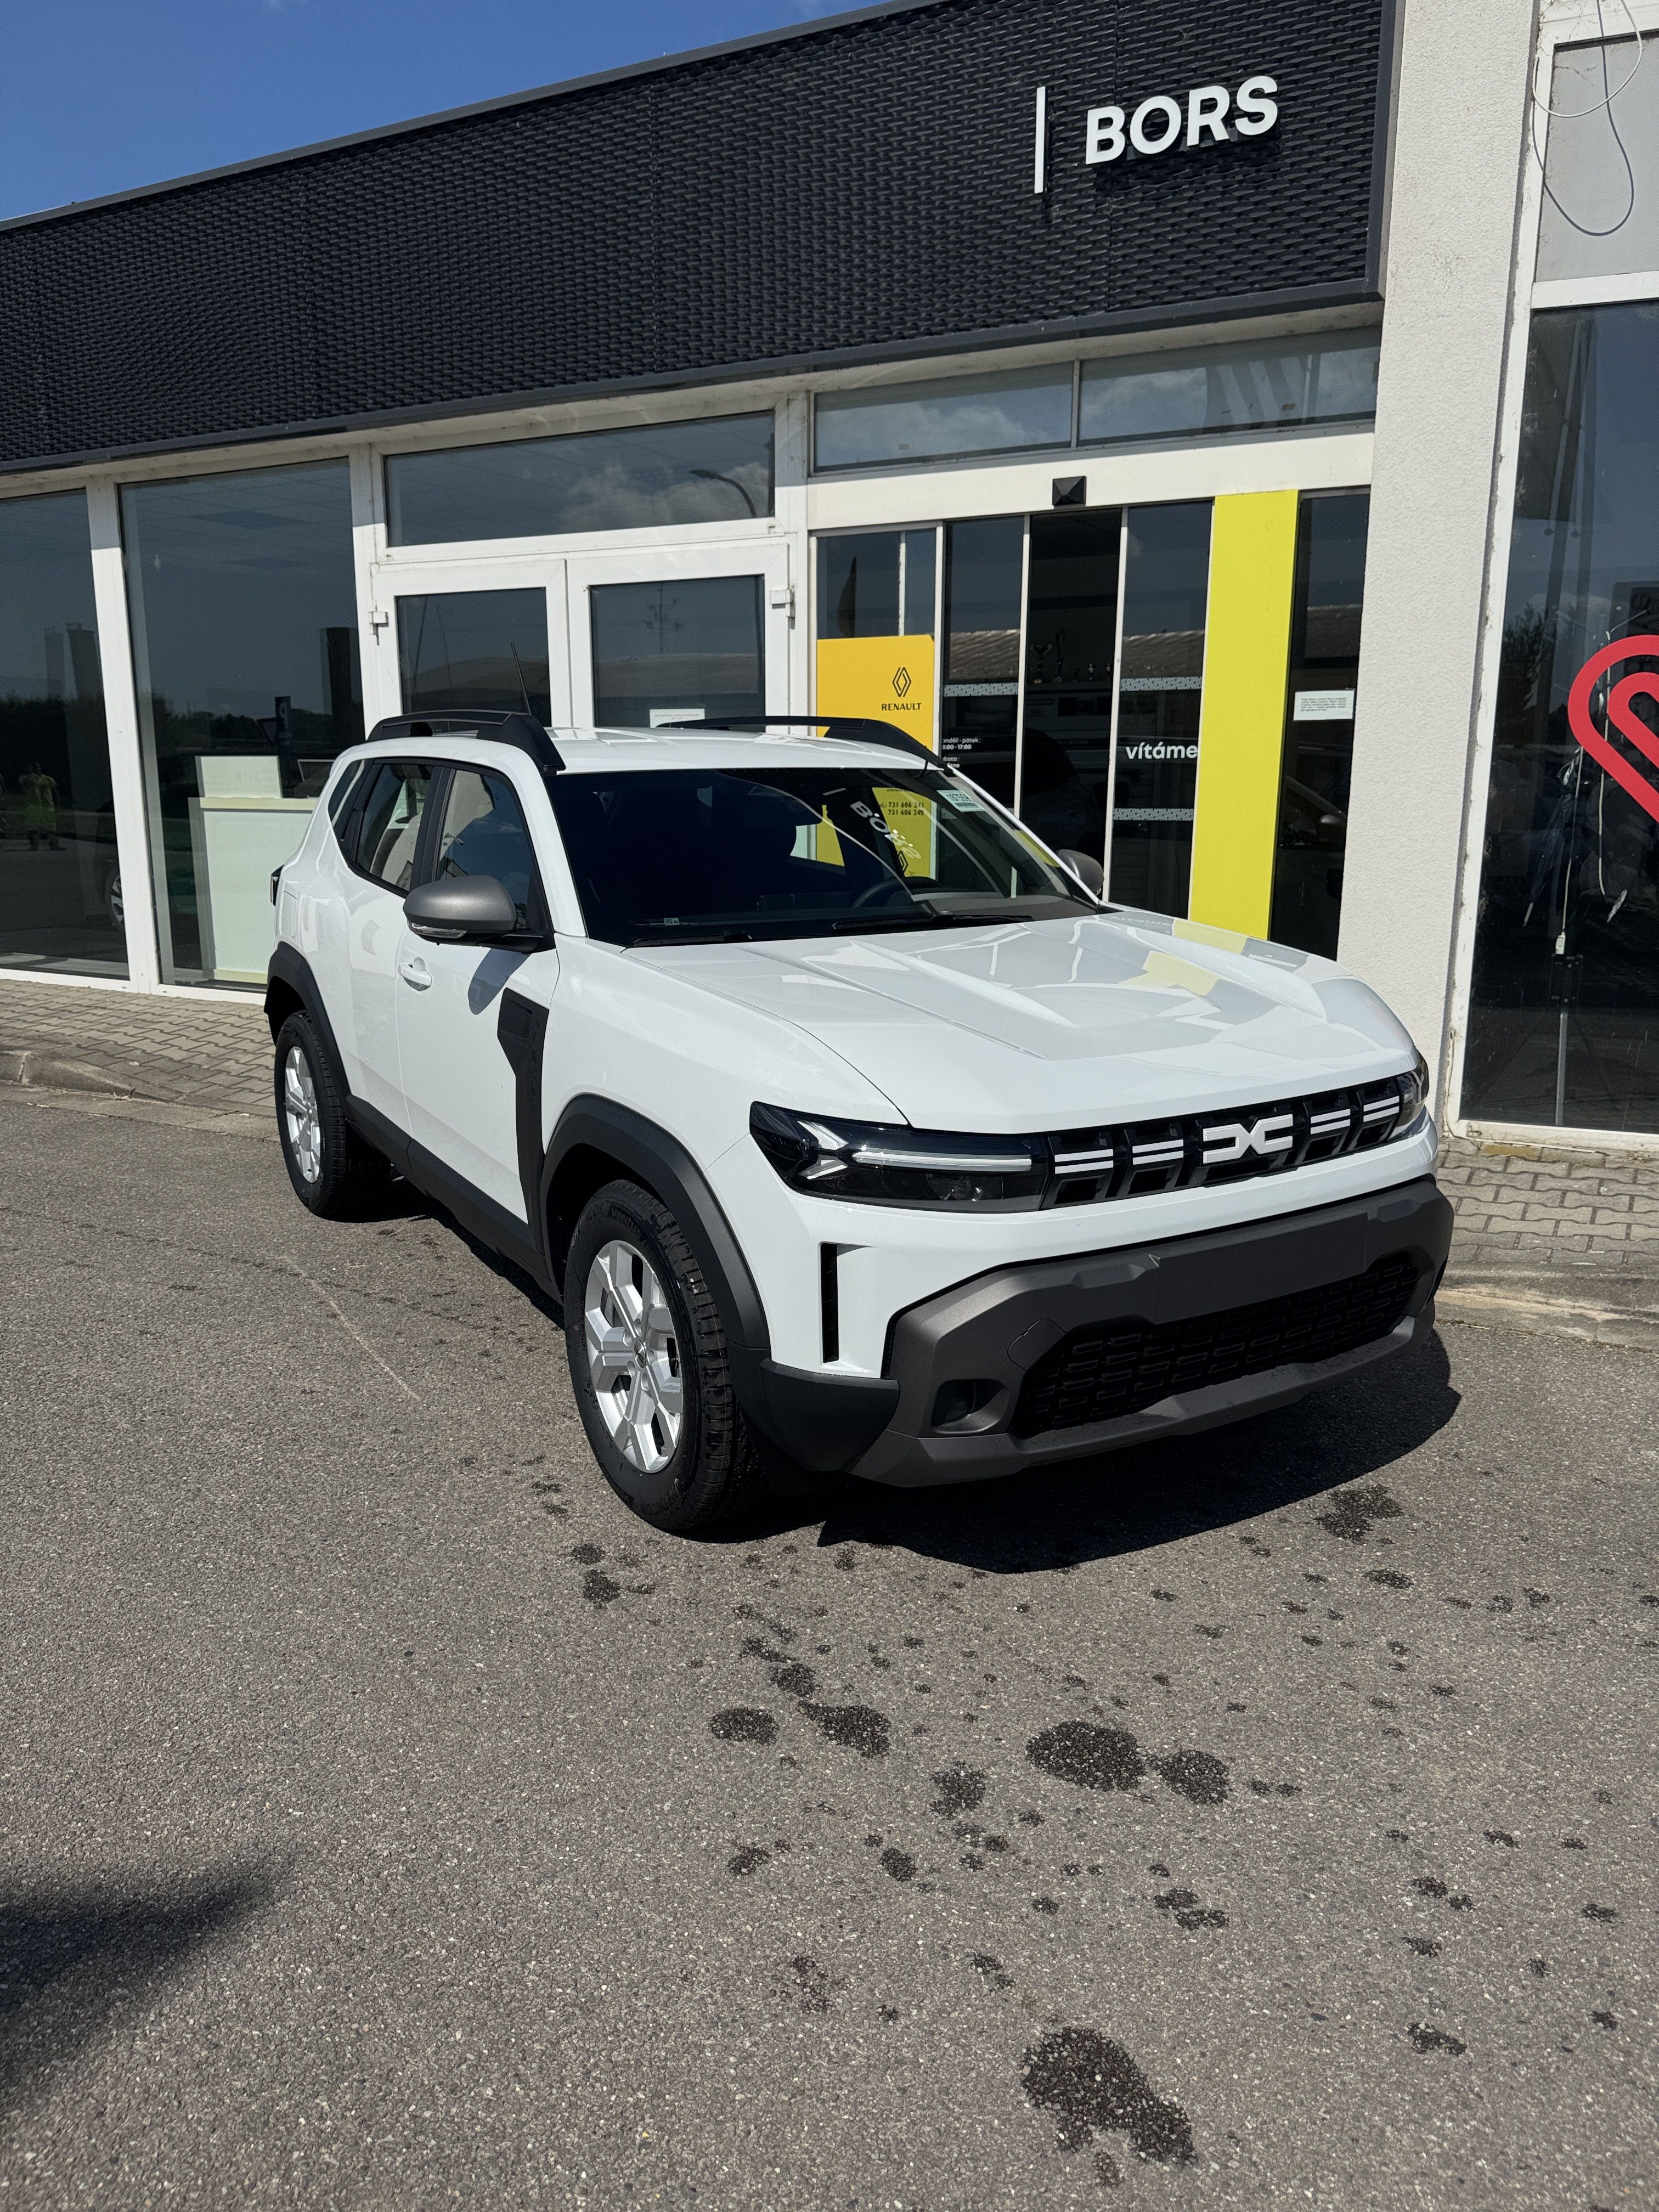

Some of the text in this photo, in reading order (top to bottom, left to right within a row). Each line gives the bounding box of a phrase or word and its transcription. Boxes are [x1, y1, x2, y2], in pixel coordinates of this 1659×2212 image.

[1086, 76, 1278, 165] BORS
[881, 703, 922, 711] RENAULT
[1125, 742, 1198, 760] vítáme
